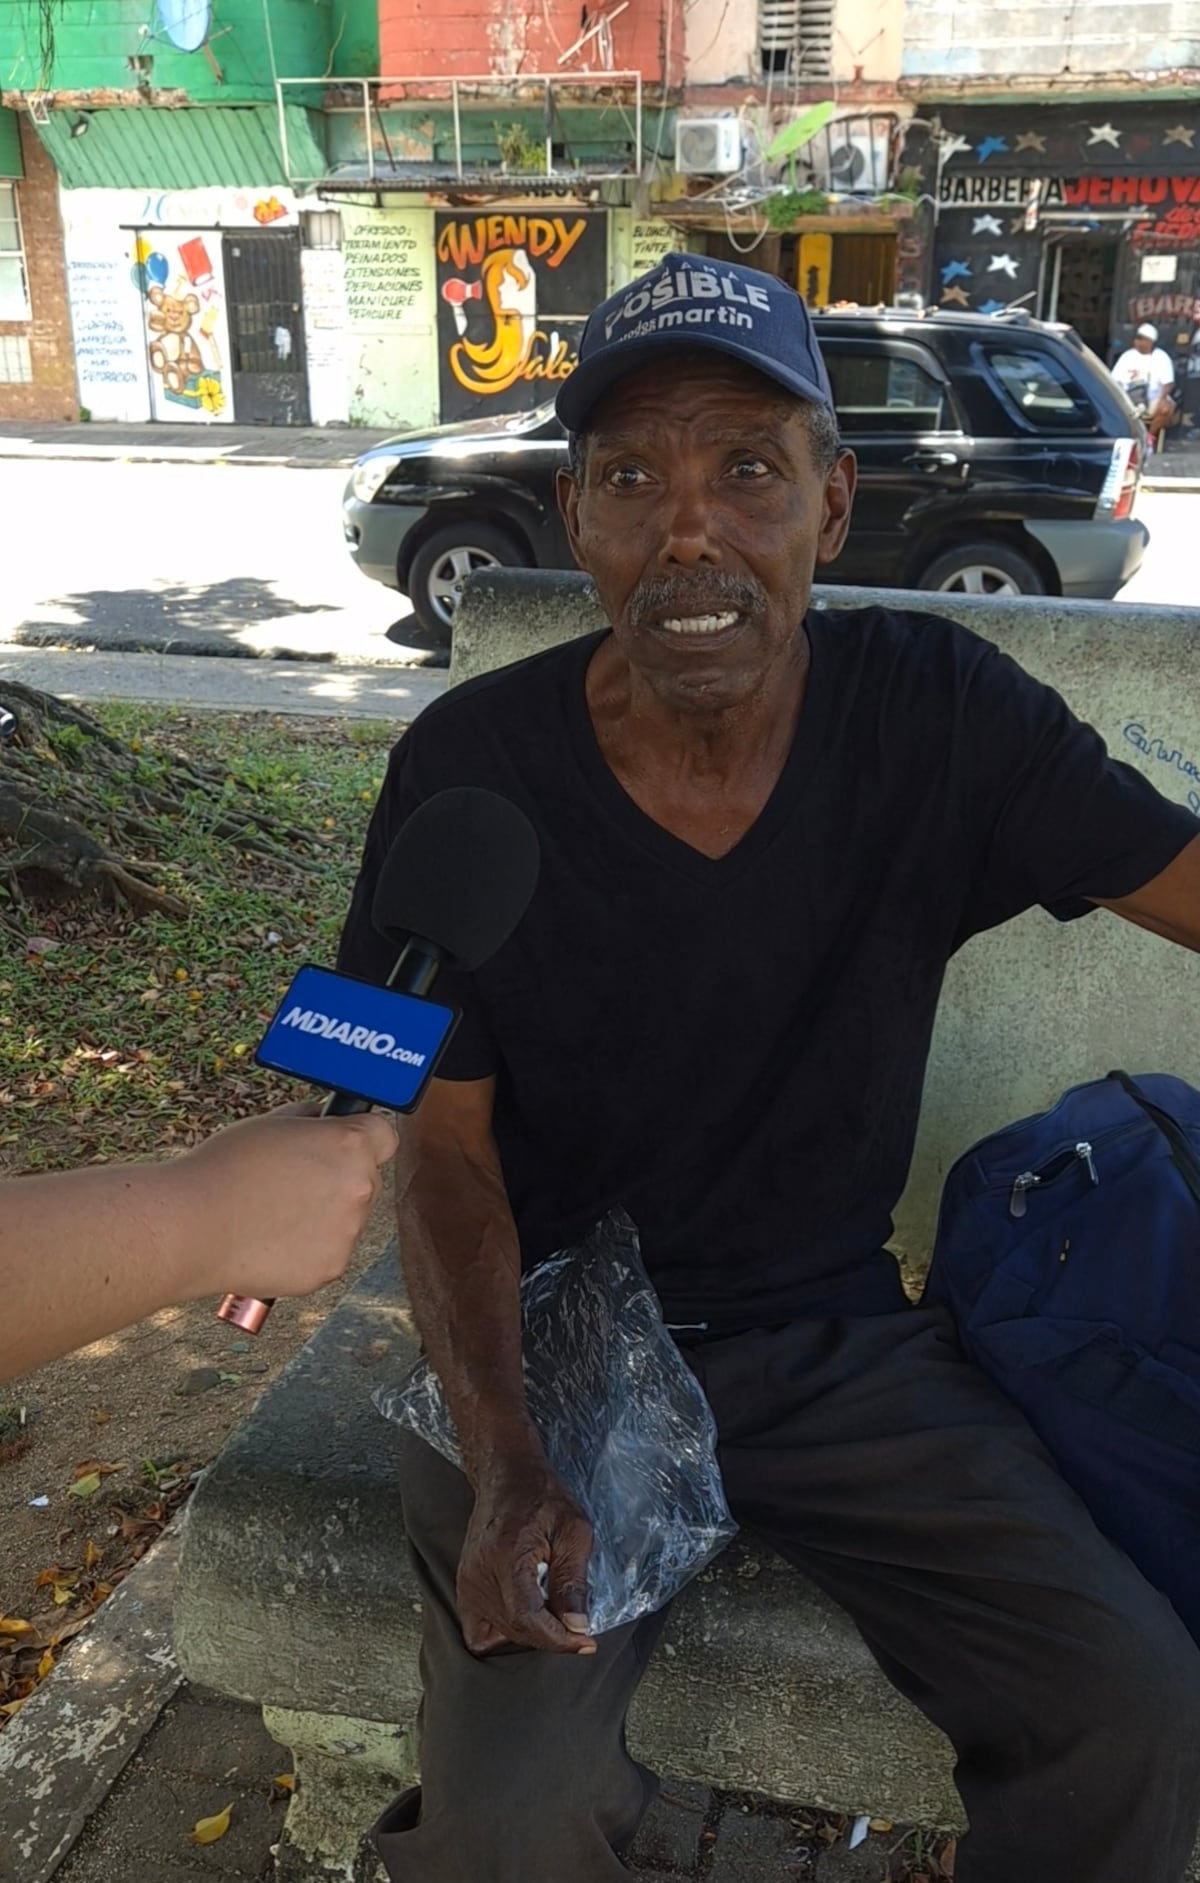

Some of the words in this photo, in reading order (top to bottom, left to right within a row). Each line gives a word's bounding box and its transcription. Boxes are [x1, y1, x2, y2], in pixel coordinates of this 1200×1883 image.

[345, 238, 417, 250] TRATAMIENTO
[438, 215, 587, 270] WENDY
[344, 252, 408, 264] PEINADOS
[343, 267, 421, 279] EXTENSIONES
[345, 280, 423, 292] DEPILACIONES
[347, 295, 415, 306] MANICURE
[348, 307, 403, 320] PEDICURE
